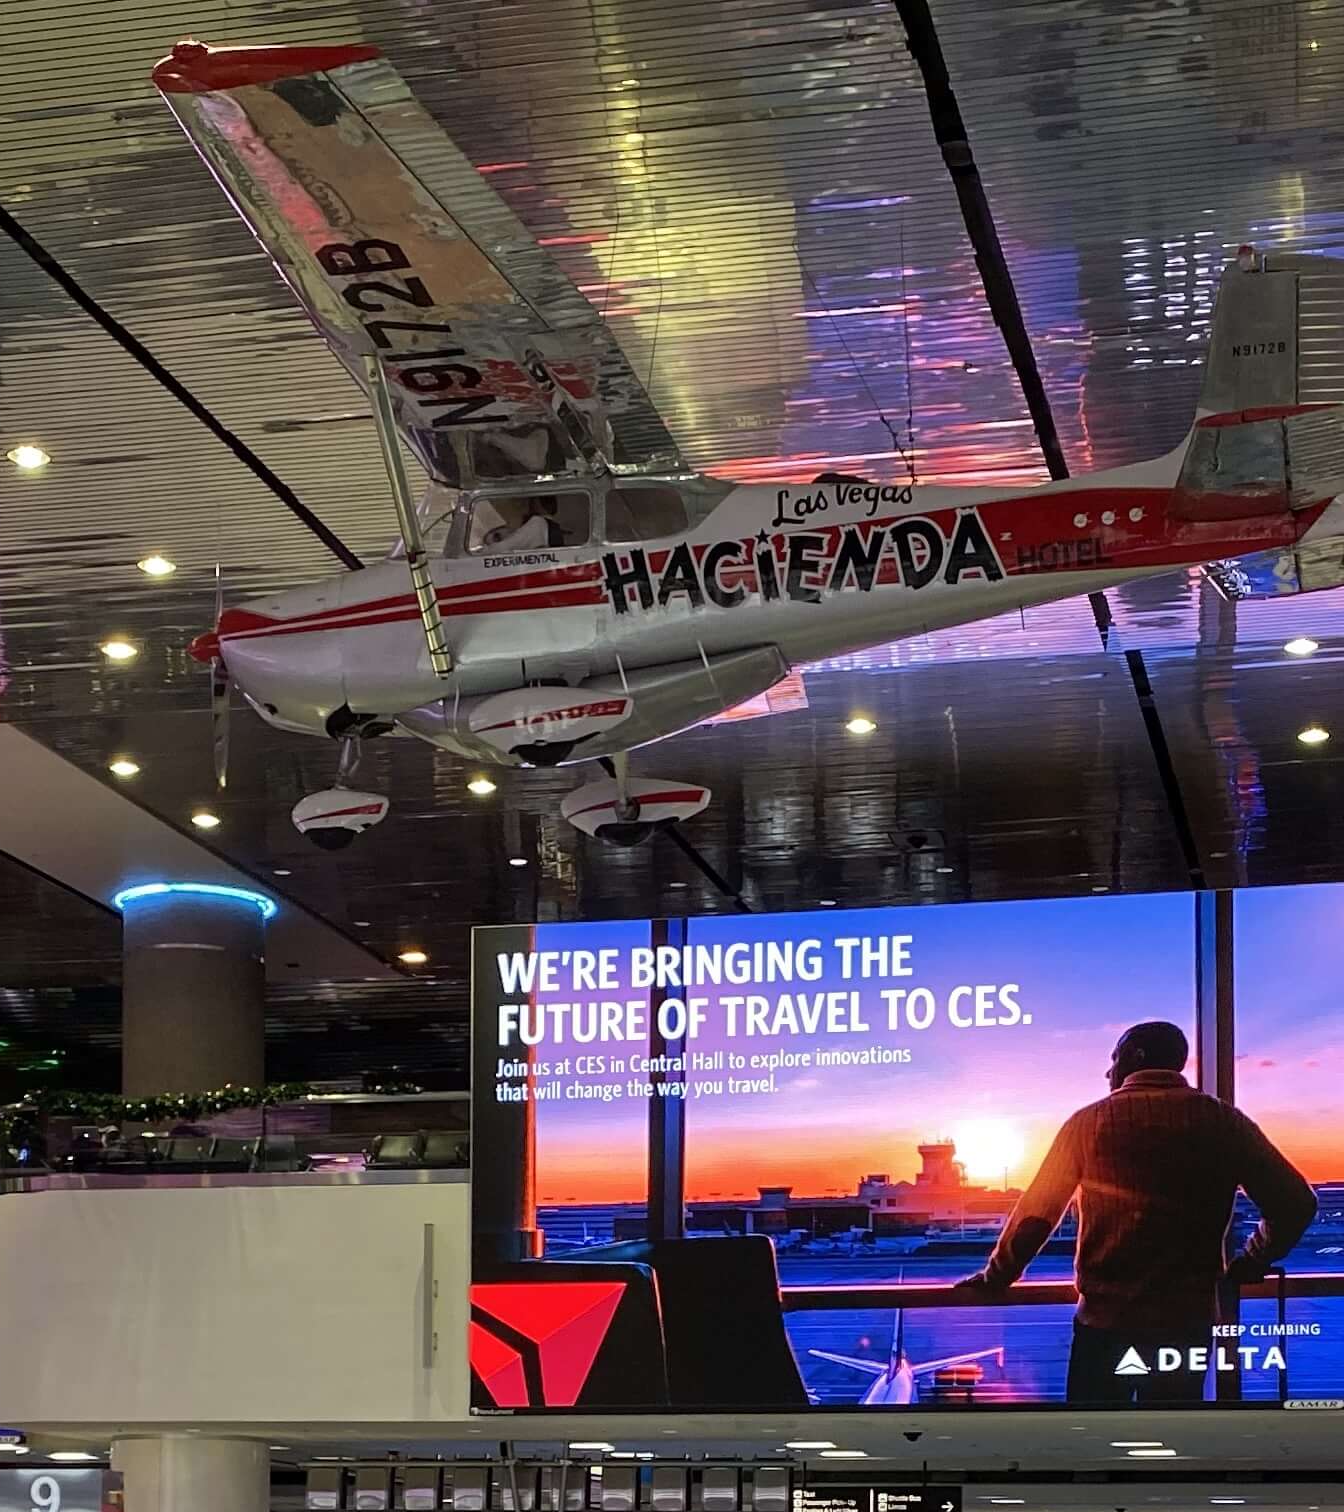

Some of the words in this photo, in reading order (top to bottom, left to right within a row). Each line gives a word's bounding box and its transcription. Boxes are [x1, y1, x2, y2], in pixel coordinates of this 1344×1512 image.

[316, 238, 509, 428] N9172B
[1232, 341, 1287, 357] N9172B
[772, 488, 827, 528] Las
[829, 482, 914, 517] Vegas
[483, 553, 560, 569] EXPERIMENTAL
[1015, 537, 1112, 567] HOTEL
[497, 948, 621, 994] WE'RE
[631, 939, 824, 988] BRINGING
[834, 935, 914, 978] THE
[497, 1002, 648, 1046] FUTURE
[657, 997, 709, 1039] OF
[719, 992, 869, 1037] TRAVEL
[880, 988, 936, 1031] TO
[947, 983, 1033, 1029] CES.
[495, 1057, 529, 1080] Join
[532, 1060, 551, 1076] us
[555, 1058, 571, 1075] at
[576, 1055, 606, 1075] CES
[610, 1055, 626, 1073] in
[629, 1052, 688, 1073] Central
[692, 1051, 724, 1070] Hall
[728, 1054, 746, 1069] to
[750, 1049, 811, 1072] explore
[815, 1045, 912, 1066] innovations
[495, 1083, 529, 1102] that
[533, 1079, 562, 1099] will
[565, 1078, 622, 1103] change
[626, 1077, 654, 1097] the
[656, 1080, 689, 1100] way
[694, 1078, 724, 1098] you
[727, 1074, 779, 1094] travel.
[1212, 1325, 1246, 1337] KEEP
[1250, 1324, 1321, 1337] CLIMBING
[1158, 1346, 1287, 1372] DELTA
[1288, 1399, 1339, 1408] LAMAR
